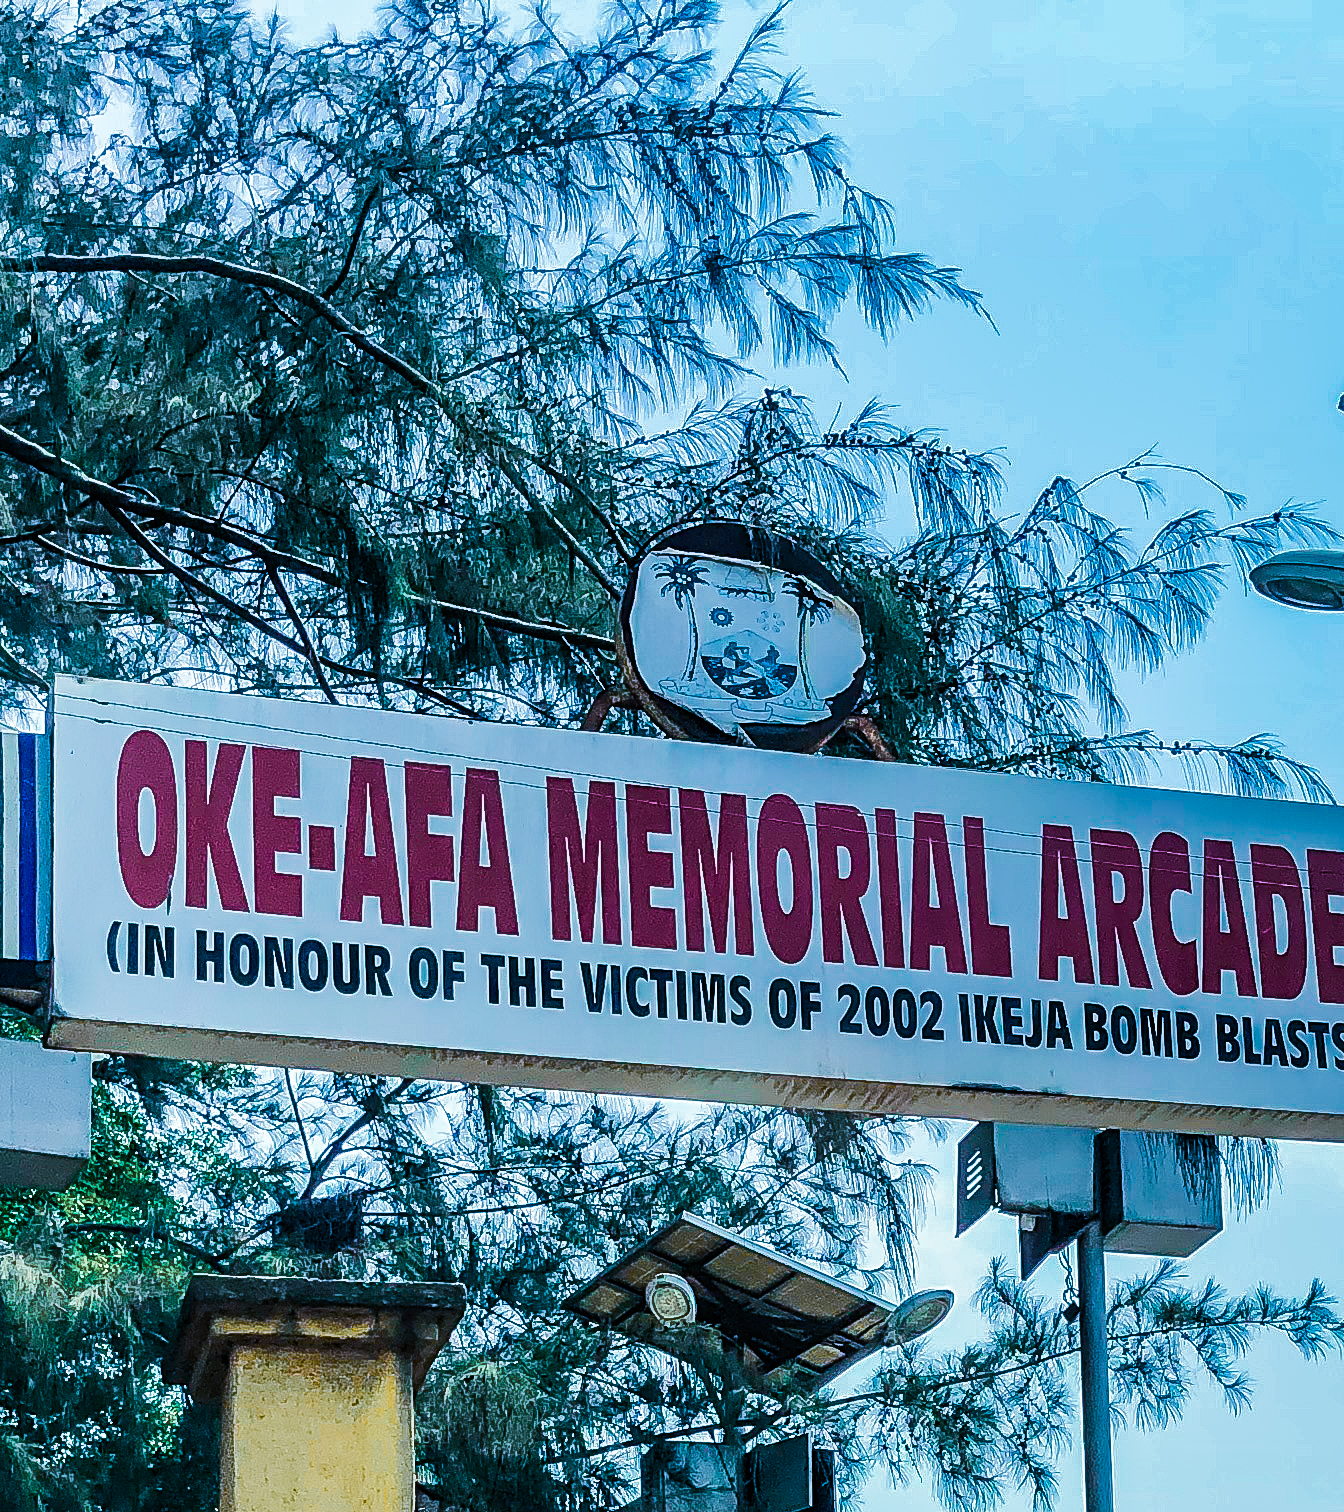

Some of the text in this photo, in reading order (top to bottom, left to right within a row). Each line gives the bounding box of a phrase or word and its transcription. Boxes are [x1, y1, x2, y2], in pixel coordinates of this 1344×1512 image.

[116, 729, 519, 935] OKE-AFA
[545, 776, 1013, 978] MEMORIAL
[107, 920, 175, 978] (IN
[195, 928, 393, 998] HONOUR
[409, 945, 465, 1000] OF
[481, 953, 563, 1009] THE
[580, 961, 752, 1026] VICTIMS
[767, 977, 822, 1031] OF
[838, 984, 944, 1041] 2002
[958, 992, 1073, 1050] IKEJA
[1085, 1003, 1200, 1060] BOMB
